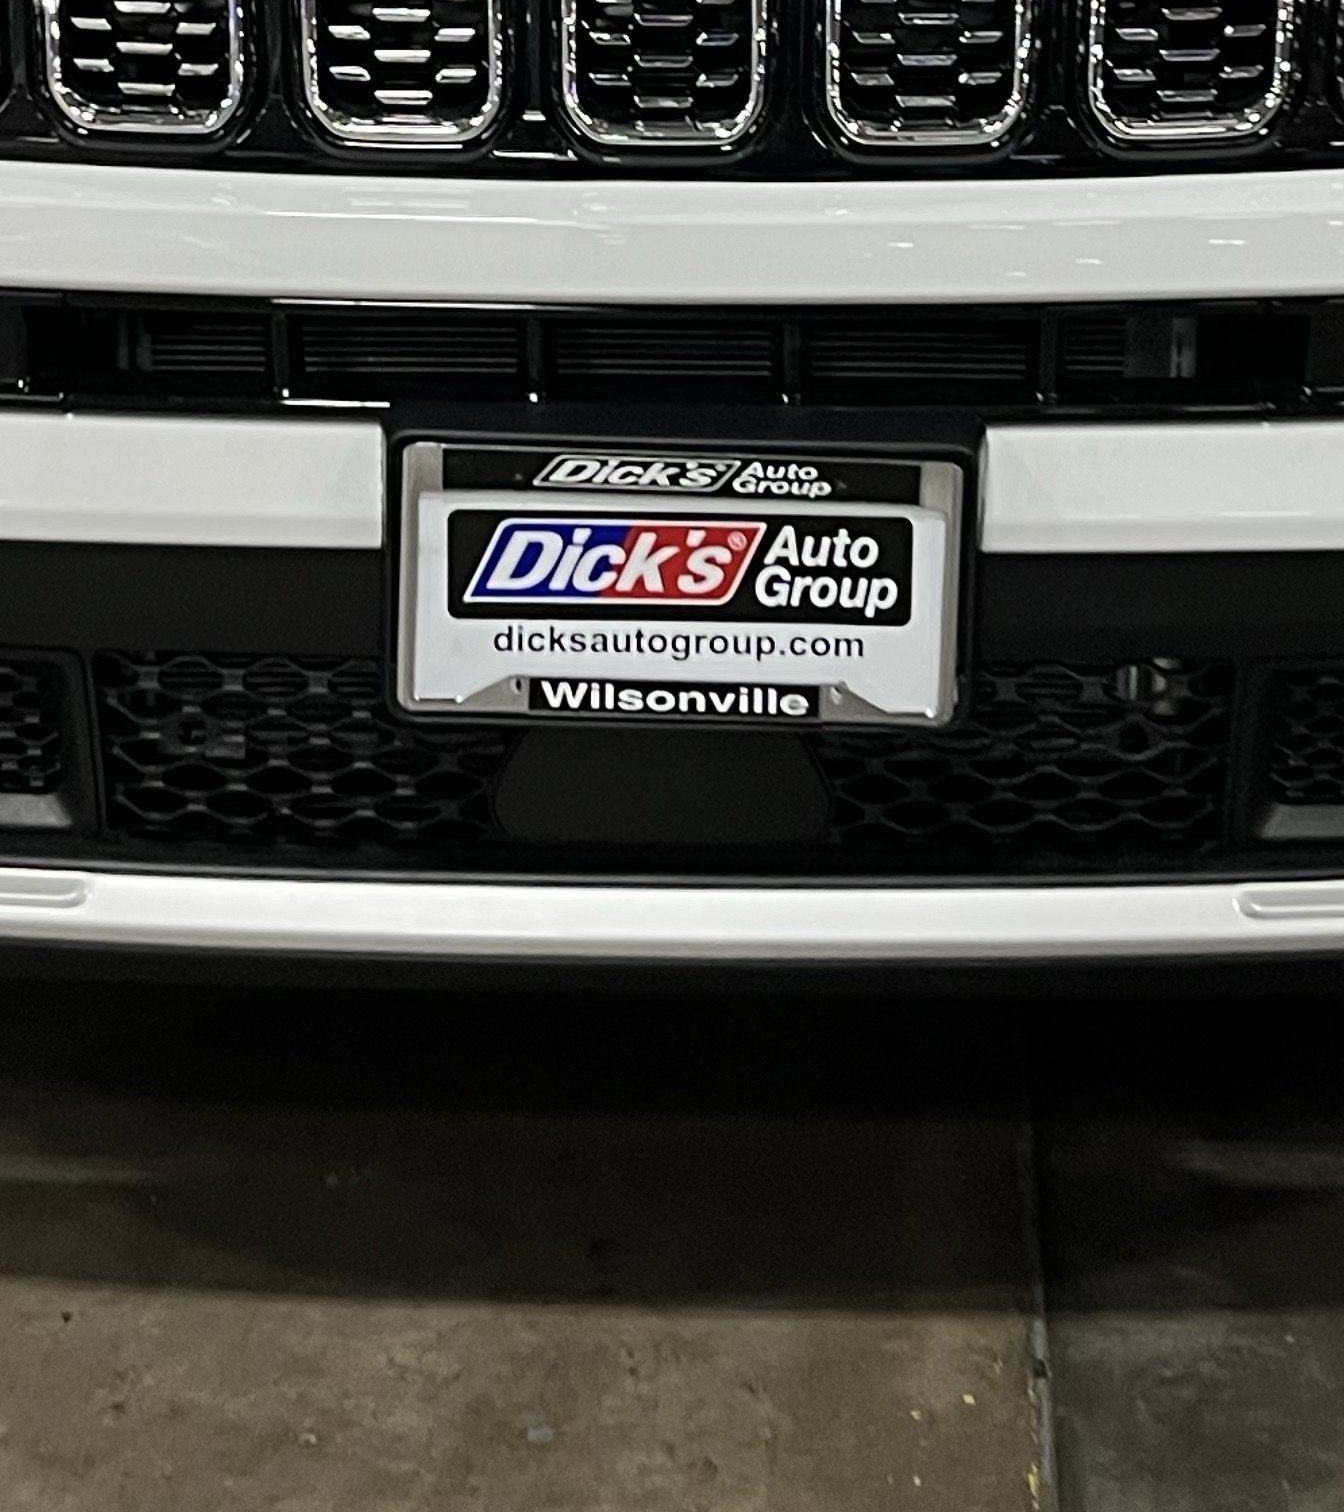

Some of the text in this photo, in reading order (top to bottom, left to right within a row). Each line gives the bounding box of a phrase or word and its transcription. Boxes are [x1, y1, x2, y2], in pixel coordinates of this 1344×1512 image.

[548, 459, 717, 488] Dick's
[732, 476, 833, 499] Group
[738, 461, 819, 481] Auto
[485, 527, 733, 594] Dick's
[763, 525, 879, 569] Auto
[755, 564, 899, 619] Group
[492, 625, 865, 661] dicksautogroup.com
[540, 679, 810, 717] Wilsonville
